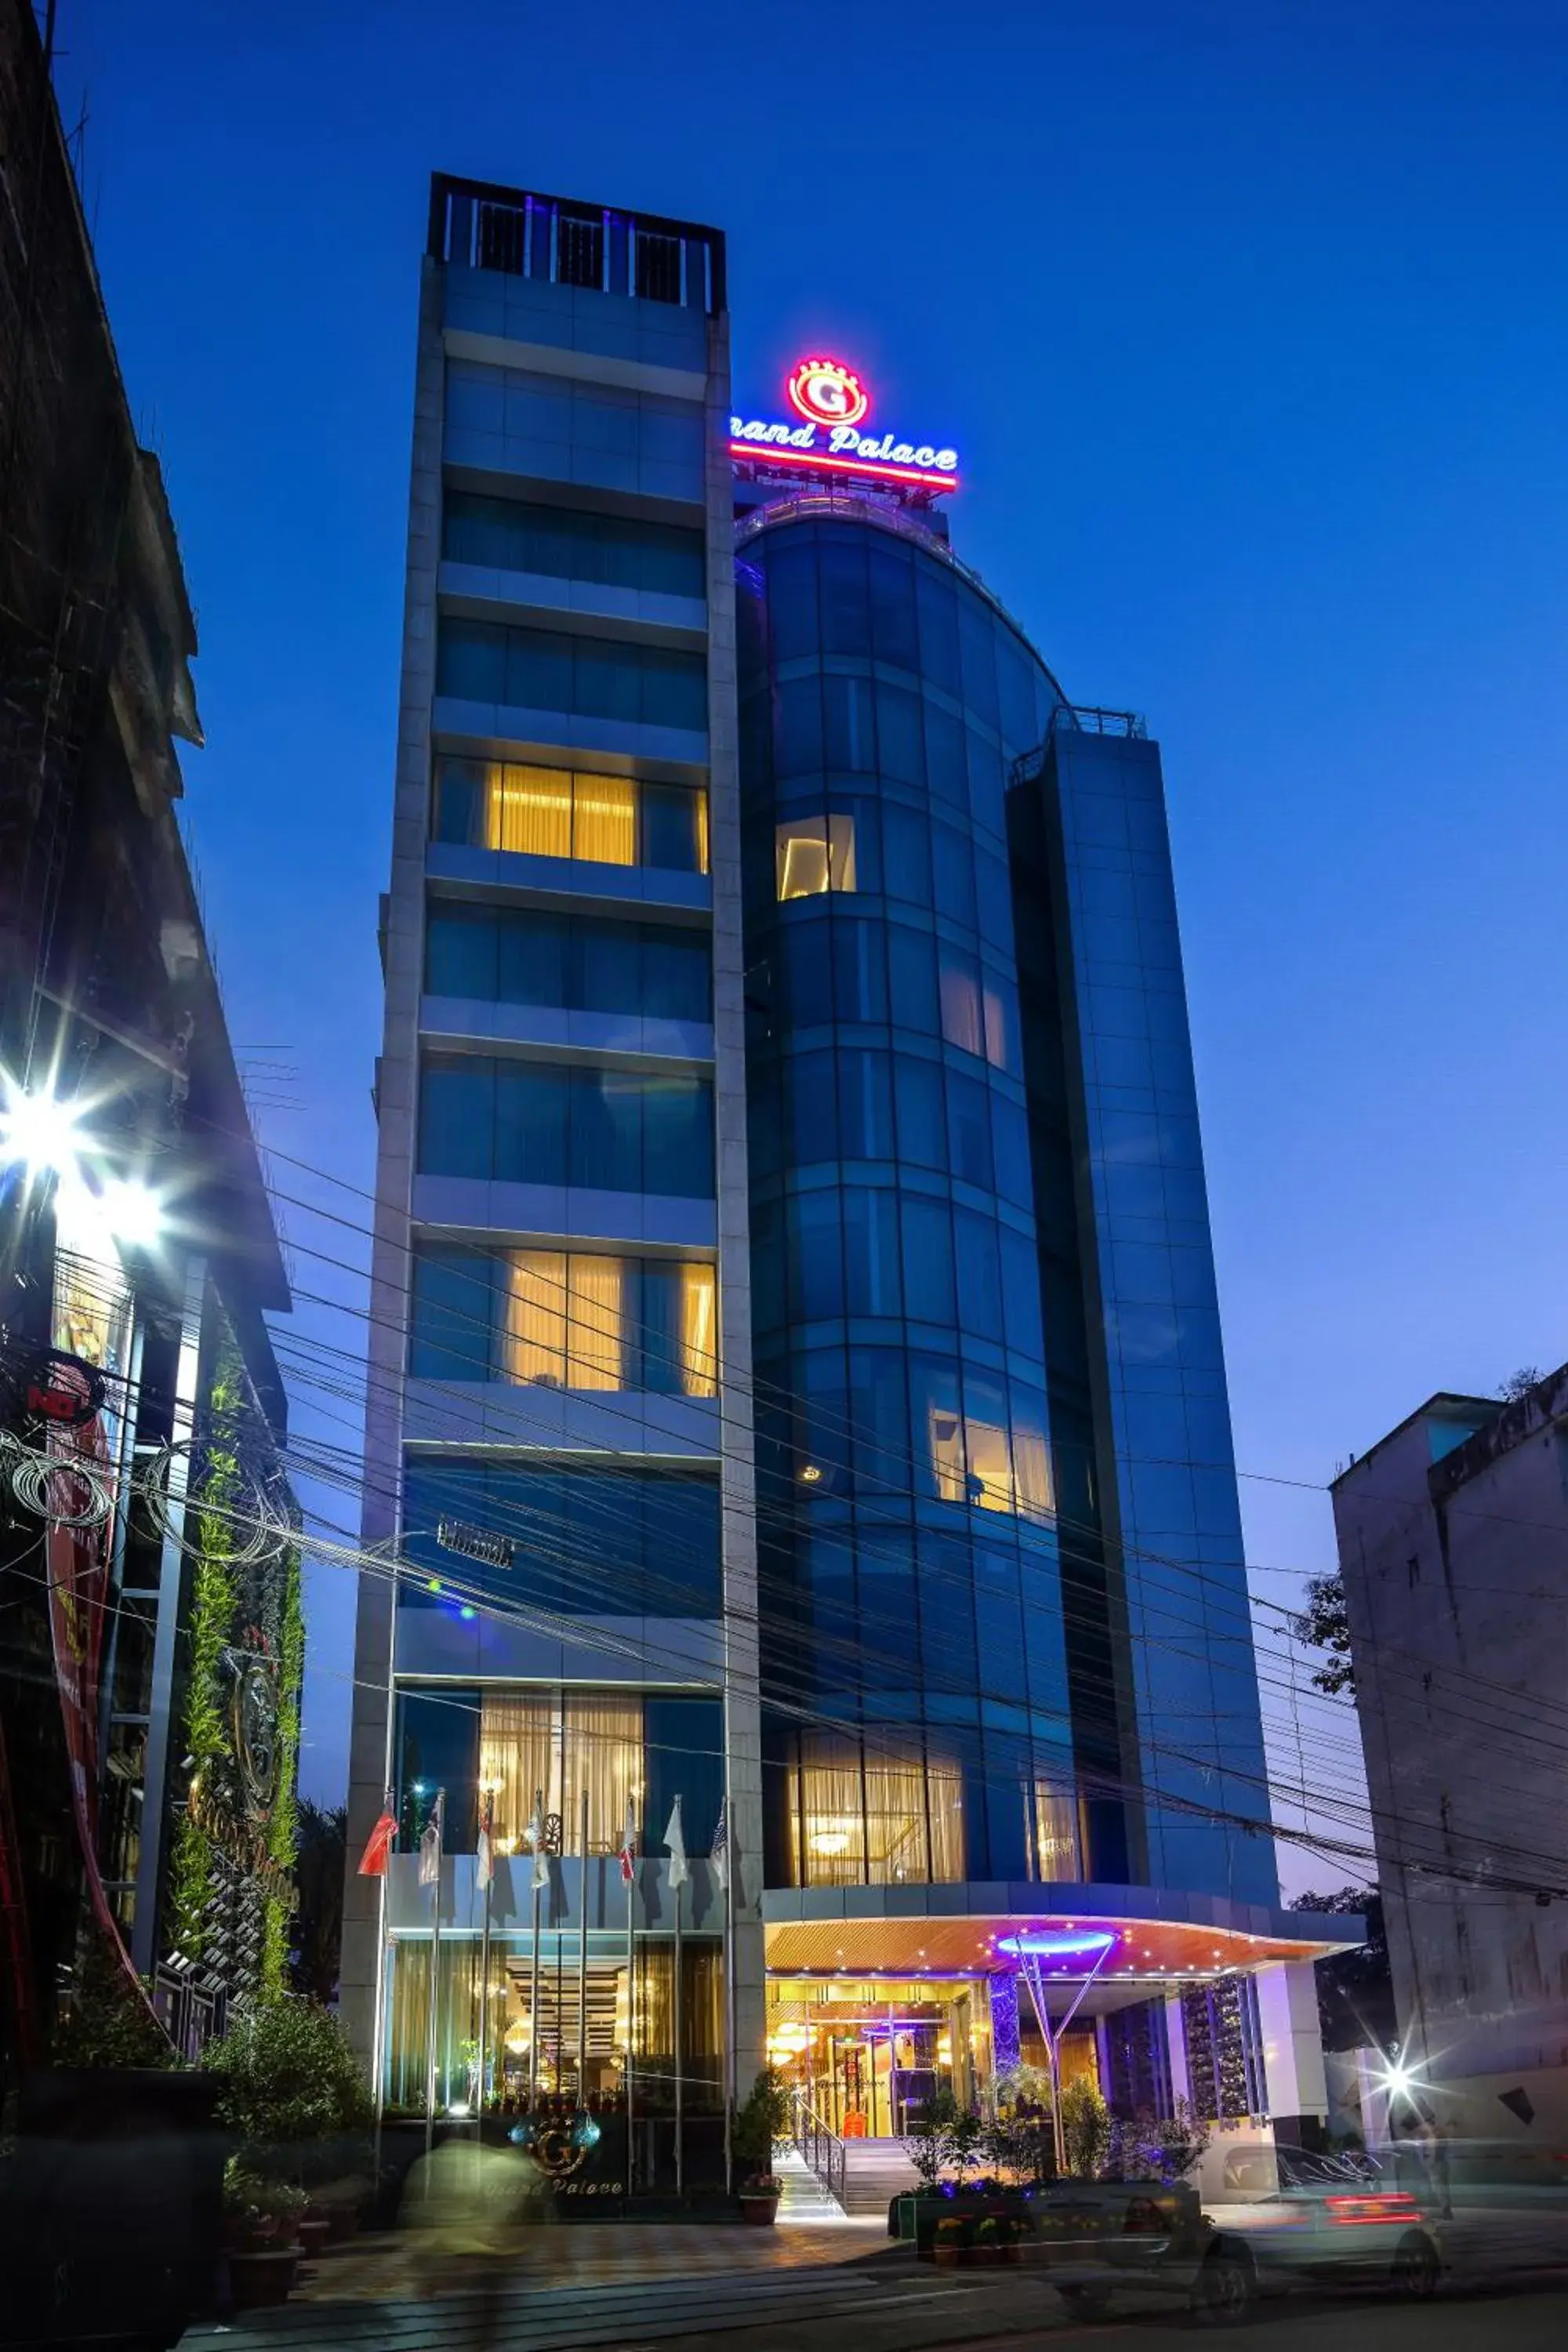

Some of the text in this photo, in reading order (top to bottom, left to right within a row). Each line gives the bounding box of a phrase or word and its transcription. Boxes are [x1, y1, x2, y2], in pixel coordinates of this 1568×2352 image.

[808, 376, 846, 414] G
[730, 416, 958, 470] rand Palace
[552, 2177, 624, 2195] Palace
